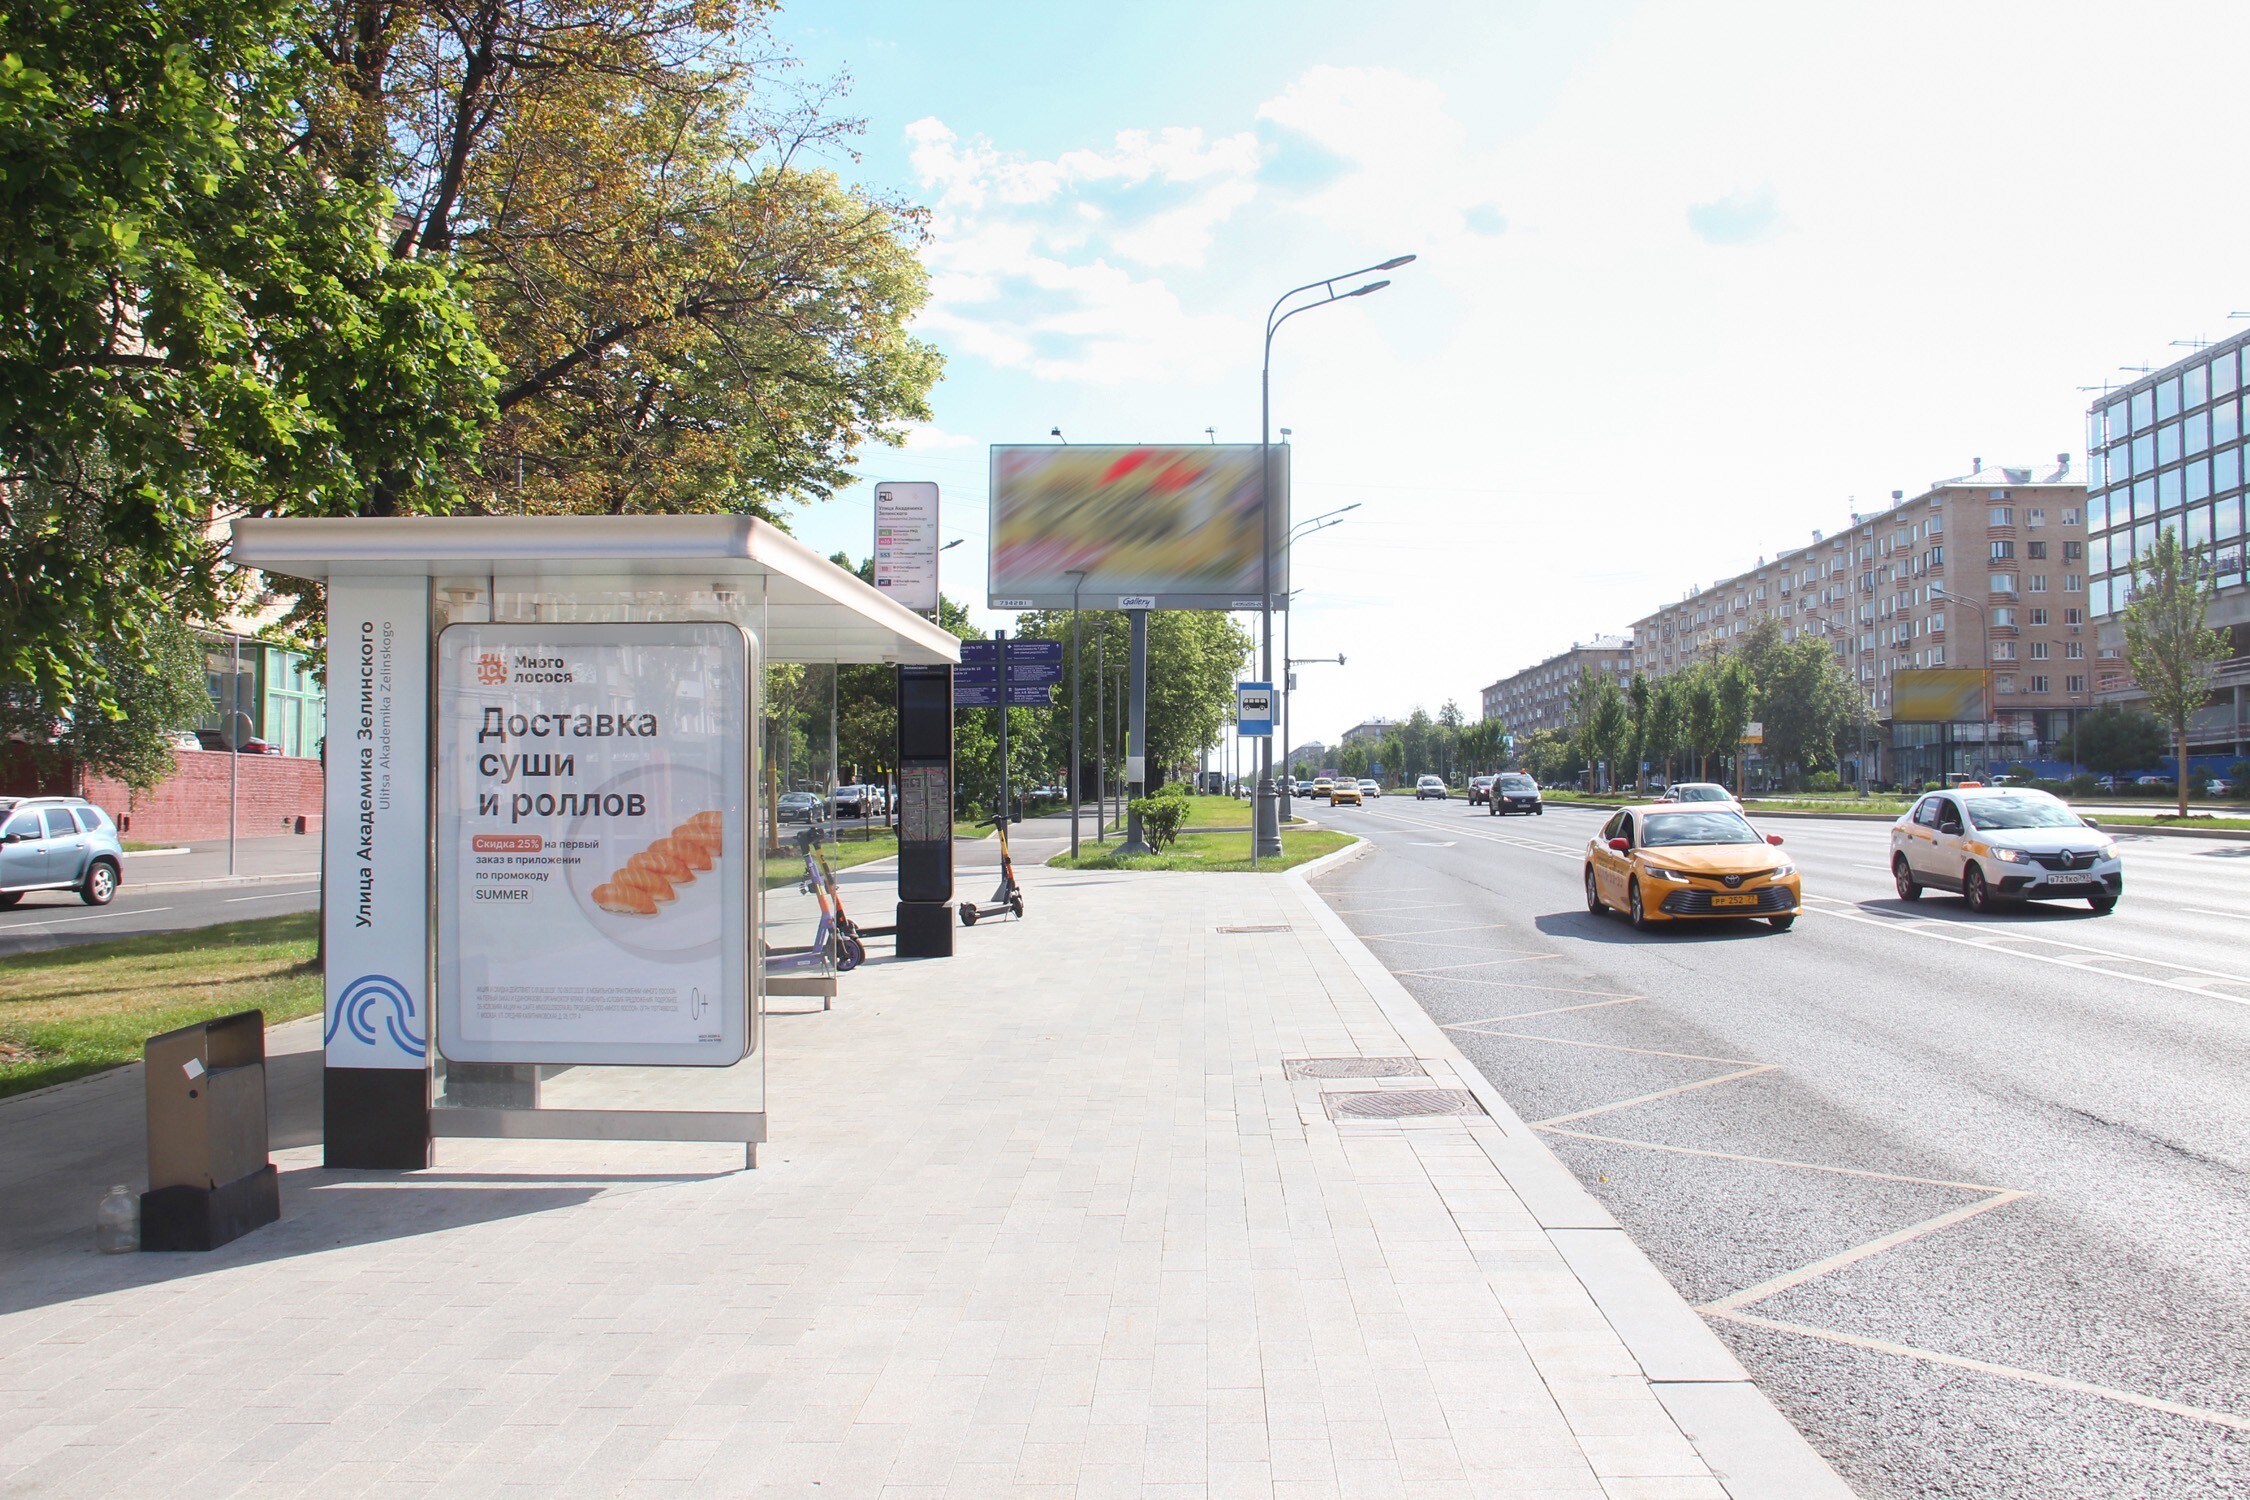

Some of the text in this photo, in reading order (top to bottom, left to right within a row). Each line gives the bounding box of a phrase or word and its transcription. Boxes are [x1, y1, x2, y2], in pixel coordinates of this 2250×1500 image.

[1122, 596, 1151, 608] Gallery
[514, 656, 564, 668] Много
[514, 673, 573, 683] лосося
[379, 621, 394, 810] Ulitsa Akademika Zelinskogo
[478, 707, 657, 743] Доставка
[356, 621, 374, 927] Улица Академика Зелинского
[479, 754, 574, 784] суши
[480, 793, 646, 824] и роллов
[476, 839, 514, 850] Скидка
[517, 839, 539, 849] 25%
[559, 840, 599, 850] первый
[516, 857, 581, 865] приложении
[476, 872, 549, 881] по промокоду
[476, 890, 528, 900] SUMMER
[1728, 896, 1743, 904] 252
[691, 986, 708, 1021] 0+
